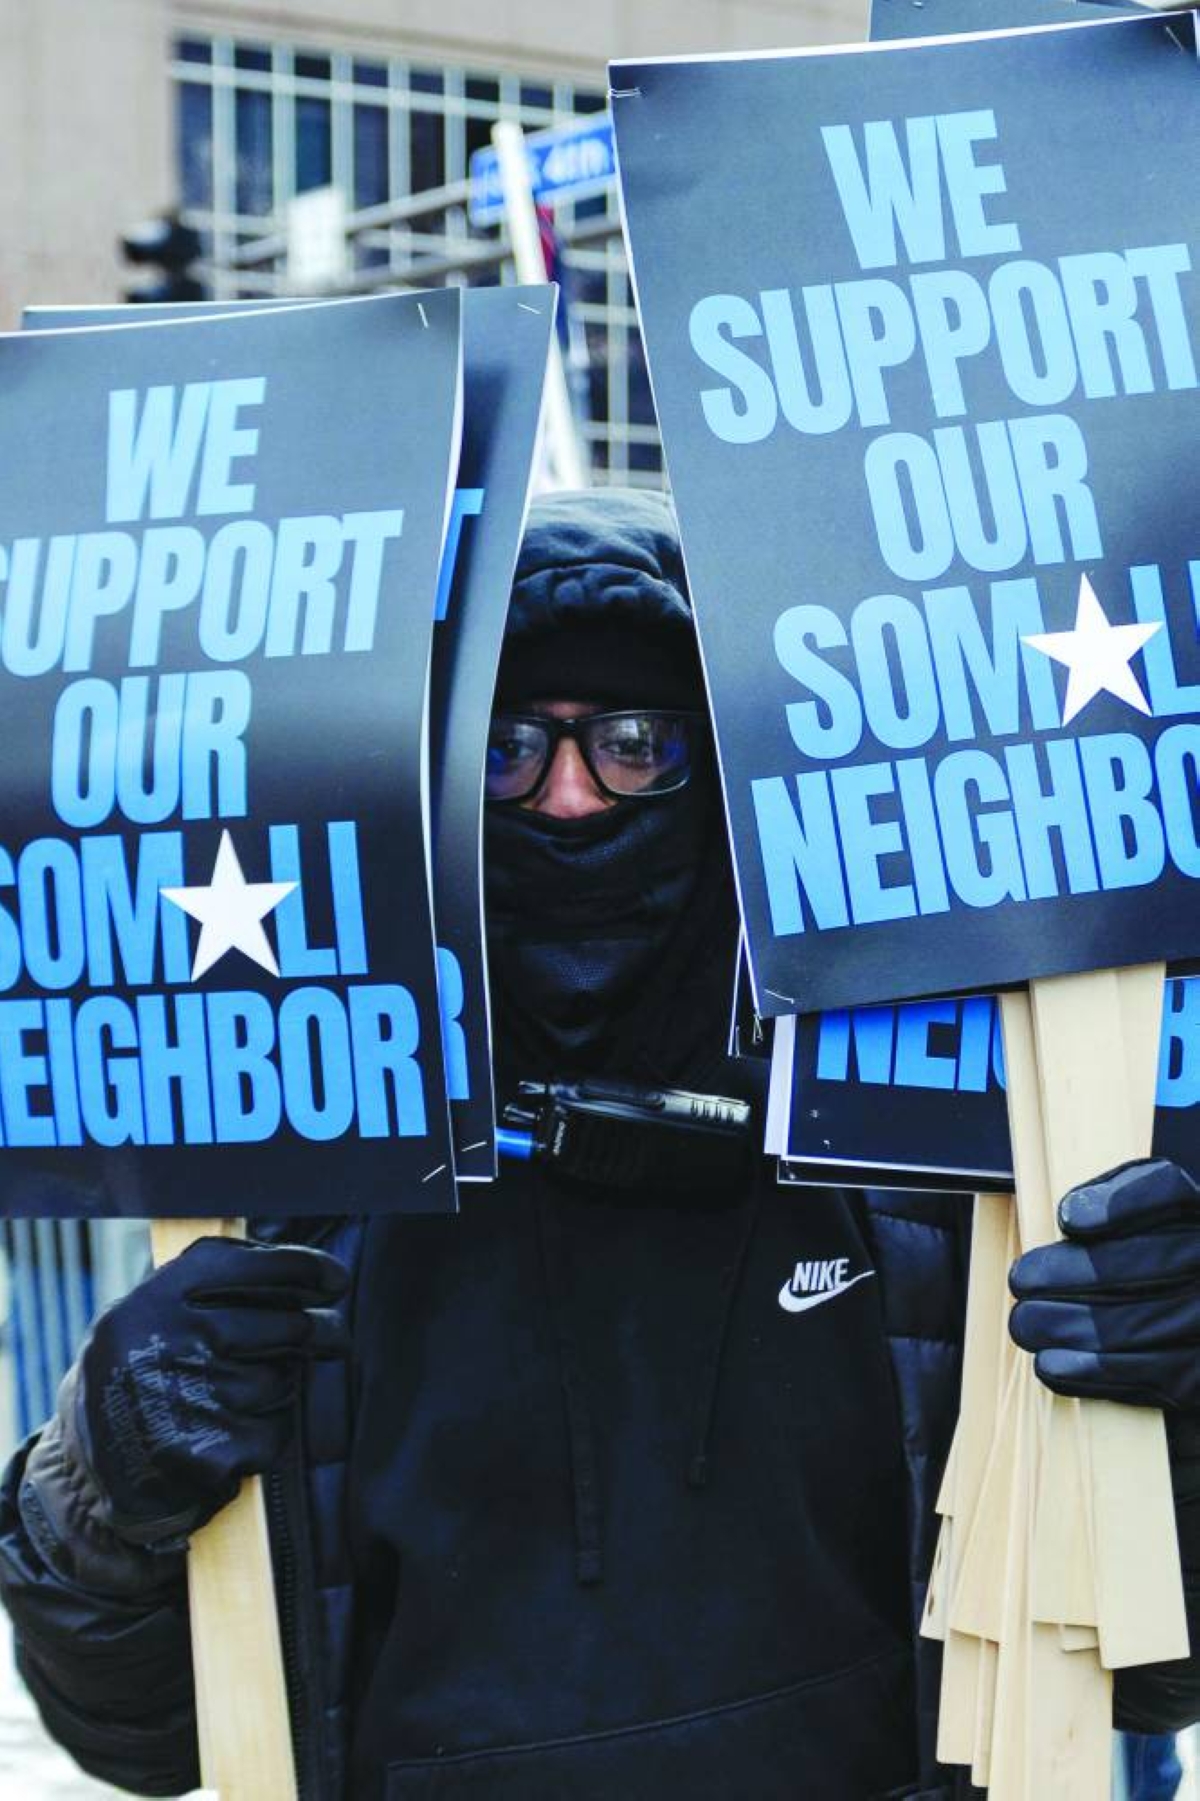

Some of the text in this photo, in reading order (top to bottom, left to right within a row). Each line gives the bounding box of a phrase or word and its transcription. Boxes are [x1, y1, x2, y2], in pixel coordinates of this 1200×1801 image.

[820, 109, 1022, 270] WE
[689, 244, 1199, 444] SUPPORT
[106, 377, 266, 523] WE
[864, 414, 1103, 581] OUR
[0, 510, 403, 677] UPPORT
[52, 670, 252, 827] OUR
[0, 984, 428, 1147] EIGHBOR
[792, 1258, 849, 1292] NIKE
